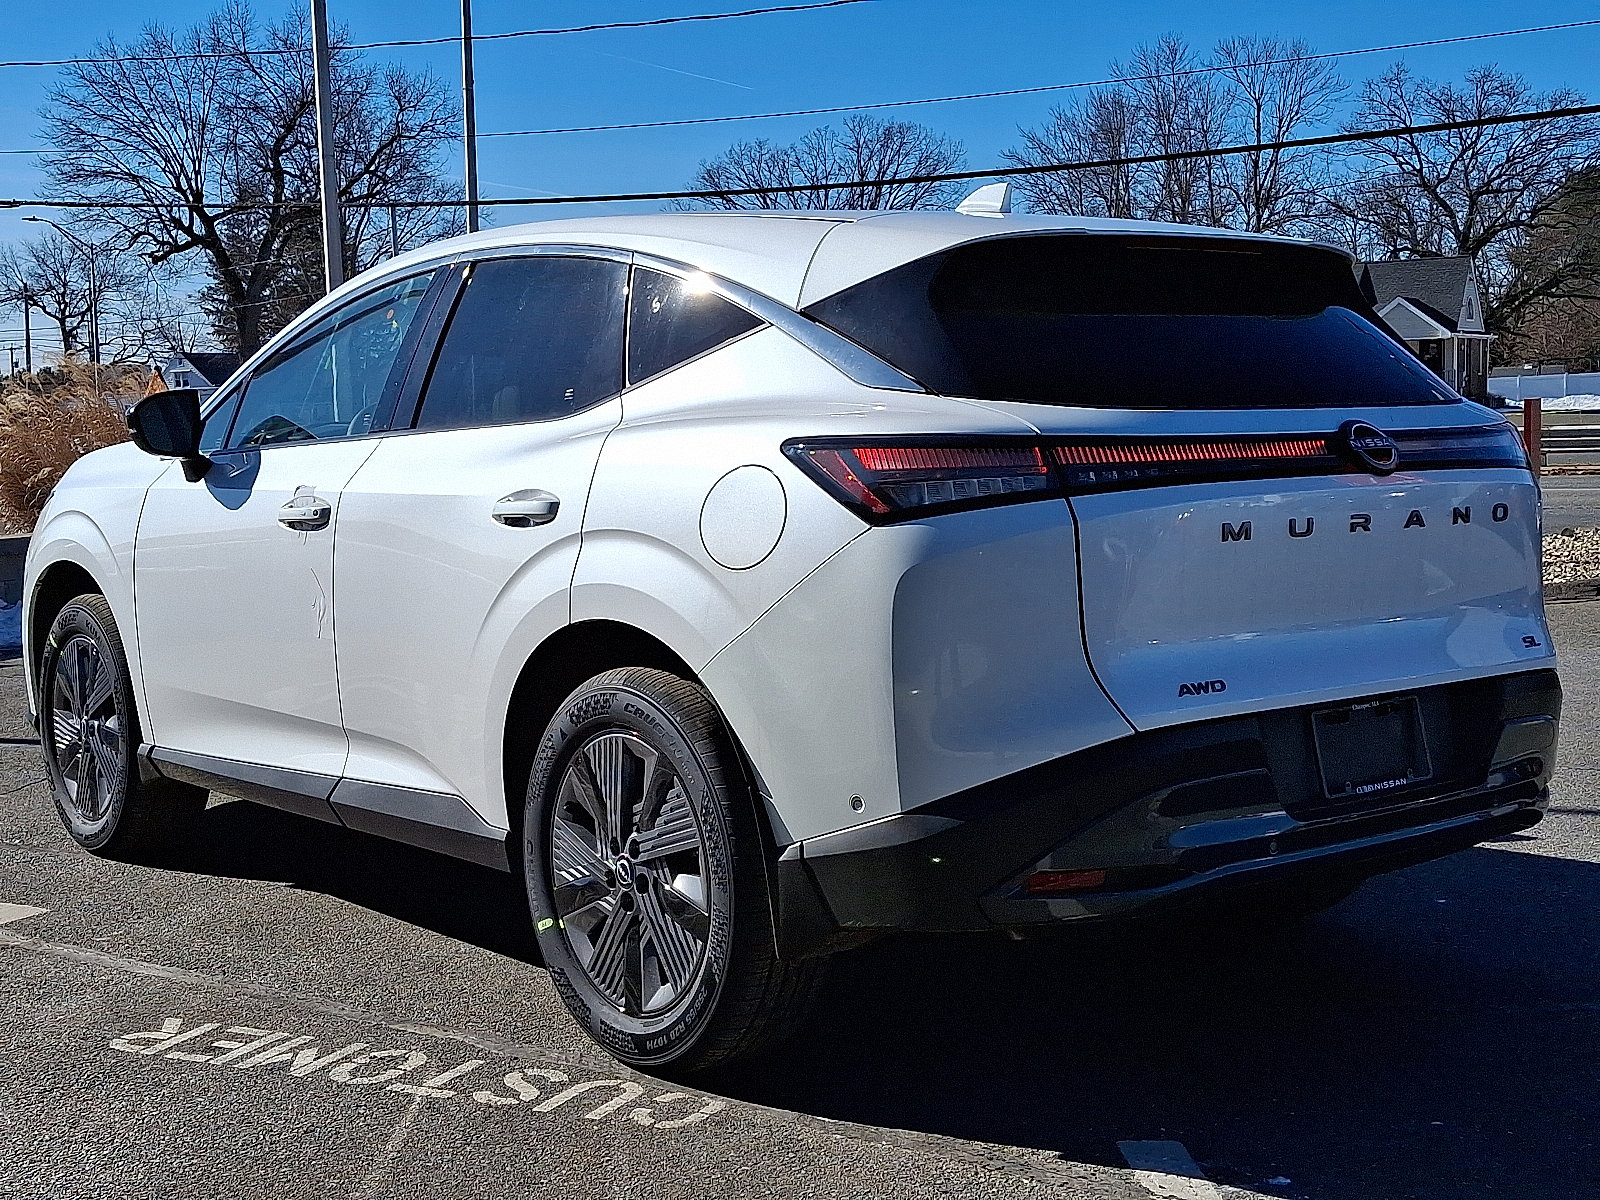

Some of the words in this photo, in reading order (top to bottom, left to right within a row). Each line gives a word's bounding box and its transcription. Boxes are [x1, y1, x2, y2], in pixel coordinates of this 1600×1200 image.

[1221, 502, 1509, 542] MURANO
[1521, 635, 1542, 648] SL
[1178, 679, 1227, 698] AWD
[1374, 777, 1407, 791] NISSAN
[669, 1021, 686, 1040] R20
[646, 1034, 668, 1050] 107H
[107, 1016, 727, 1130] CUSTOMER
